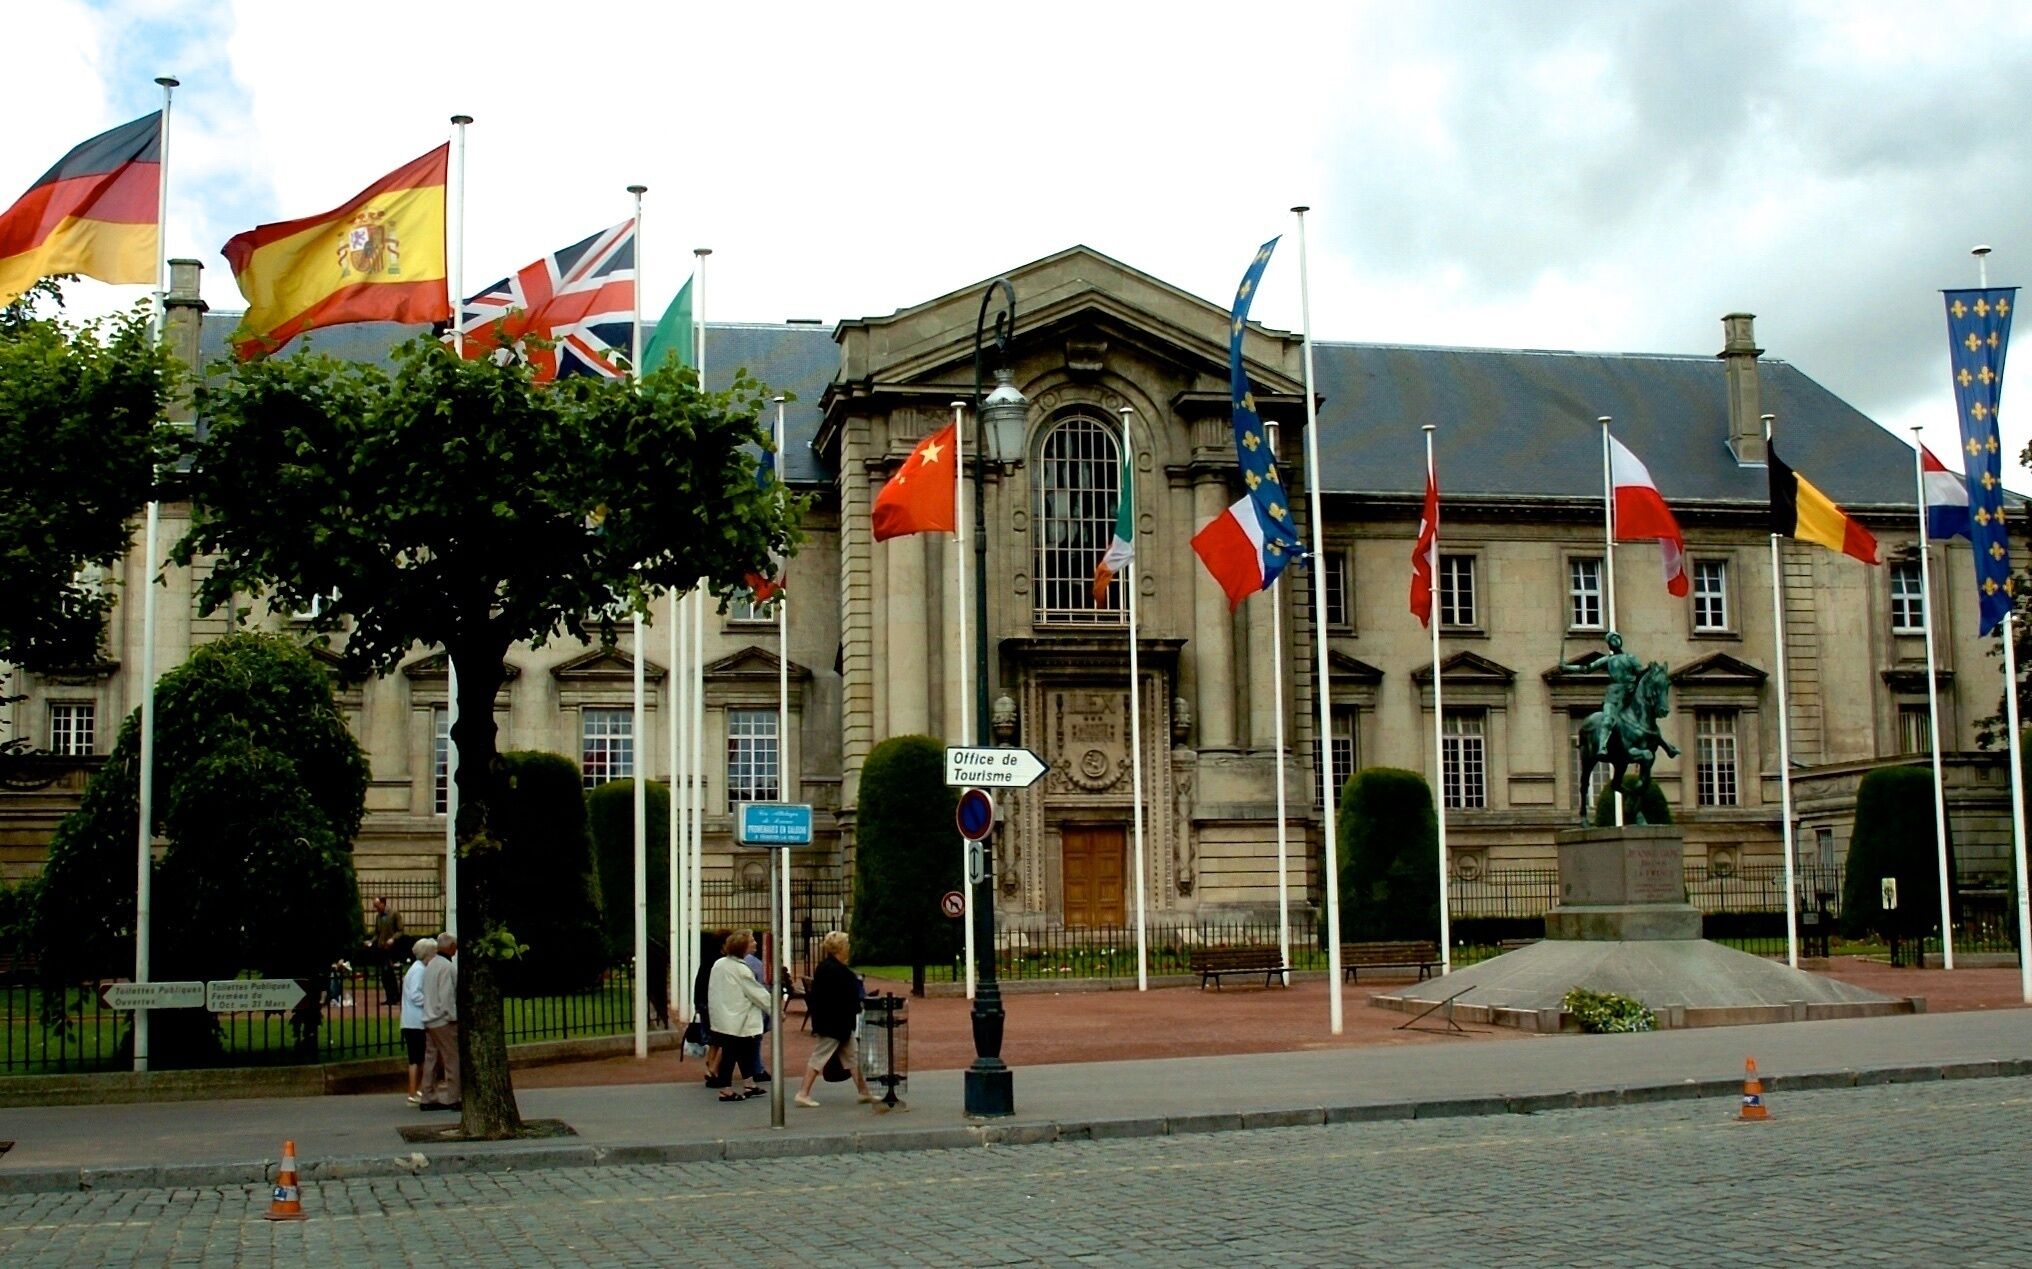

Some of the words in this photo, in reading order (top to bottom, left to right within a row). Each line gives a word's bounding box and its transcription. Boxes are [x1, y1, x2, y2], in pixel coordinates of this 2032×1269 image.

[953, 751, 995, 766] Office
[1002, 753, 1018, 766] de
[954, 767, 1013, 782] Tourisme
[115, 987, 155, 996] Toilettes
[158, 985, 203, 995] Publiques
[211, 982, 248, 991] Toilettes
[250, 982, 291, 991] Publiques
[115, 998, 156, 1006] Ouvertes
[264, 999, 286, 1008] Mars
